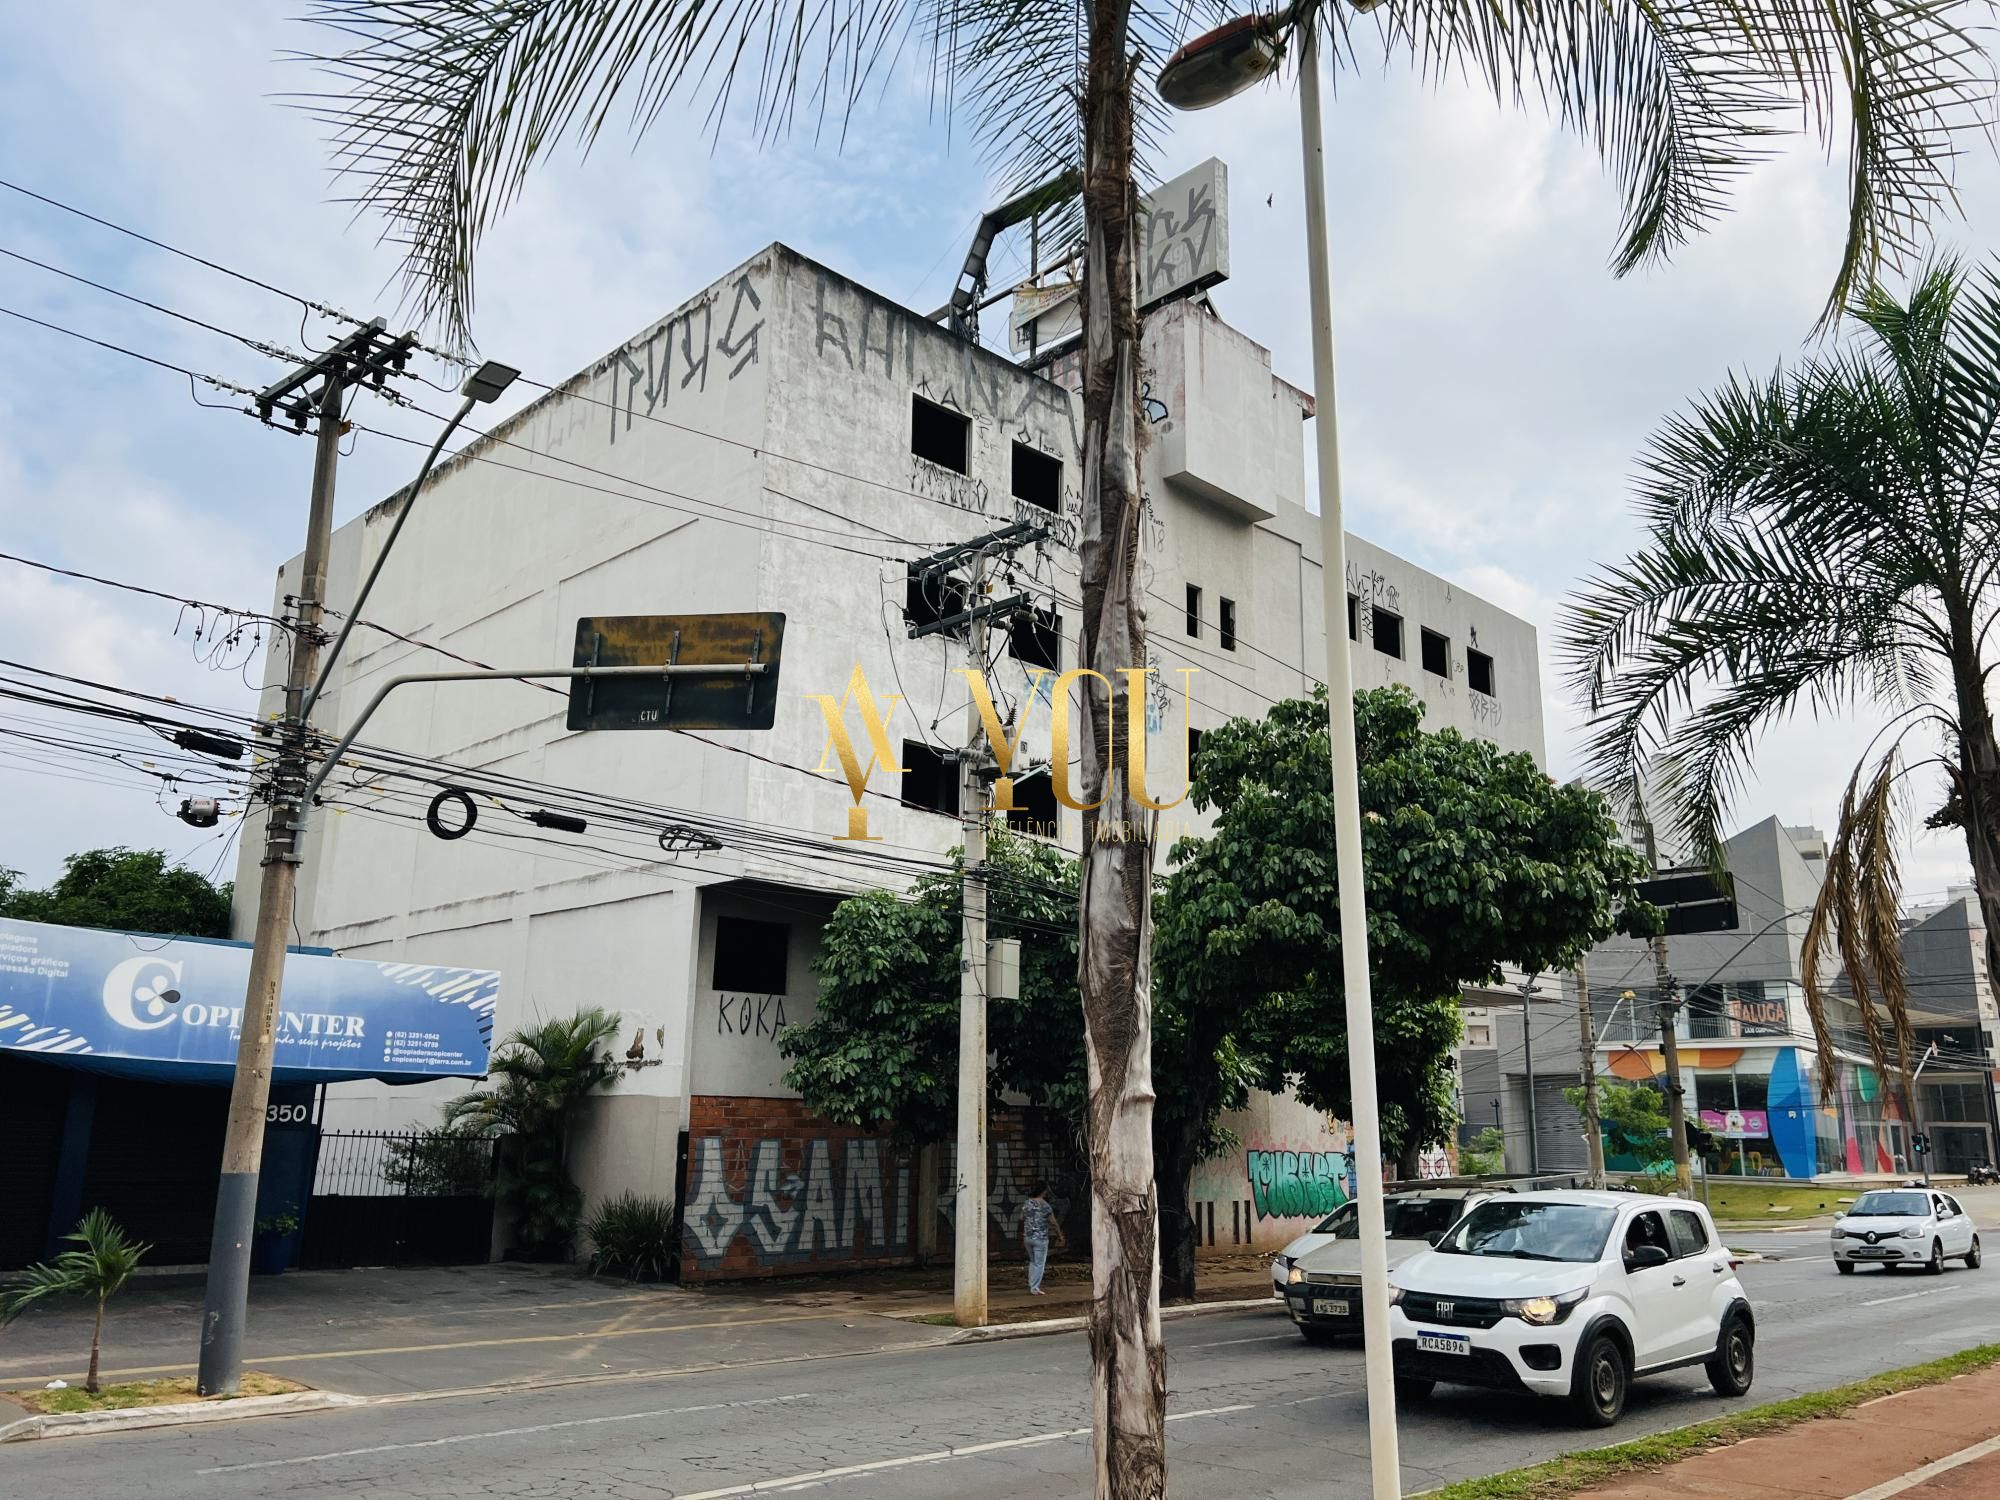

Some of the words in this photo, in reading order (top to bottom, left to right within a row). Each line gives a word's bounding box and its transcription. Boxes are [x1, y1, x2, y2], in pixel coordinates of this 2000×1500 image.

[1742, 1002, 1786, 1022] ALUGA
[266, 1104, 307, 1122] 350
[1436, 1302, 1455, 1313] FIAT
[1421, 1337, 1464, 1353] RCA5B96
